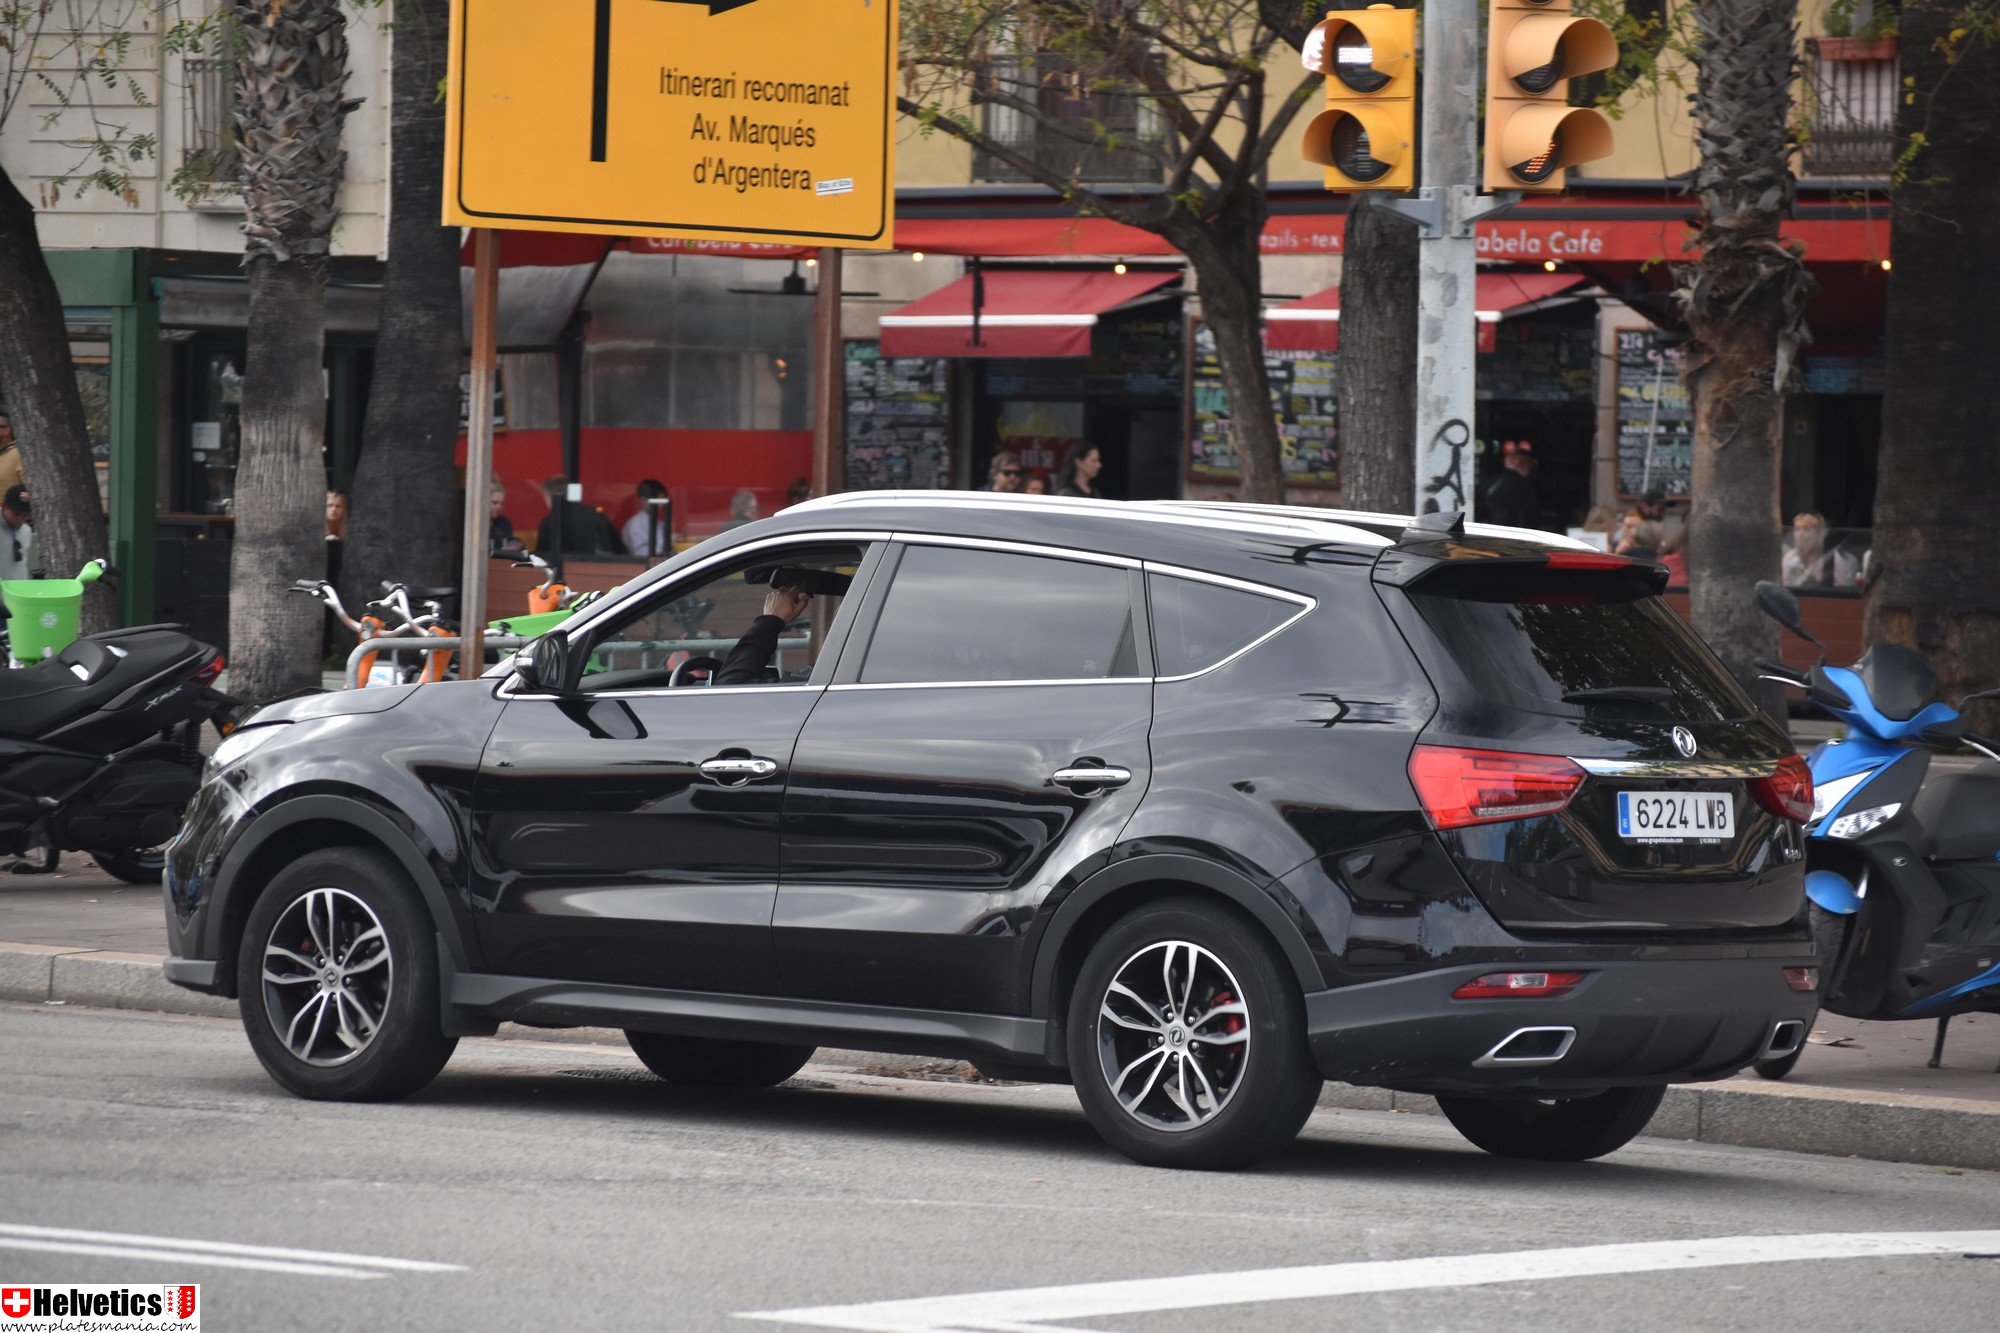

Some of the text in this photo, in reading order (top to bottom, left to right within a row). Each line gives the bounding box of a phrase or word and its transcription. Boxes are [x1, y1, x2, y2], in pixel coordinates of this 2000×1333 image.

[660, 66, 850, 107] Itinerari recomanat
[690, 112, 816, 152] Av. Marqués
[693, 156, 811, 193] d'Argentera
[1476, 228, 1541, 254] abela
[1637, 798, 1727, 830] 6224 LWB
